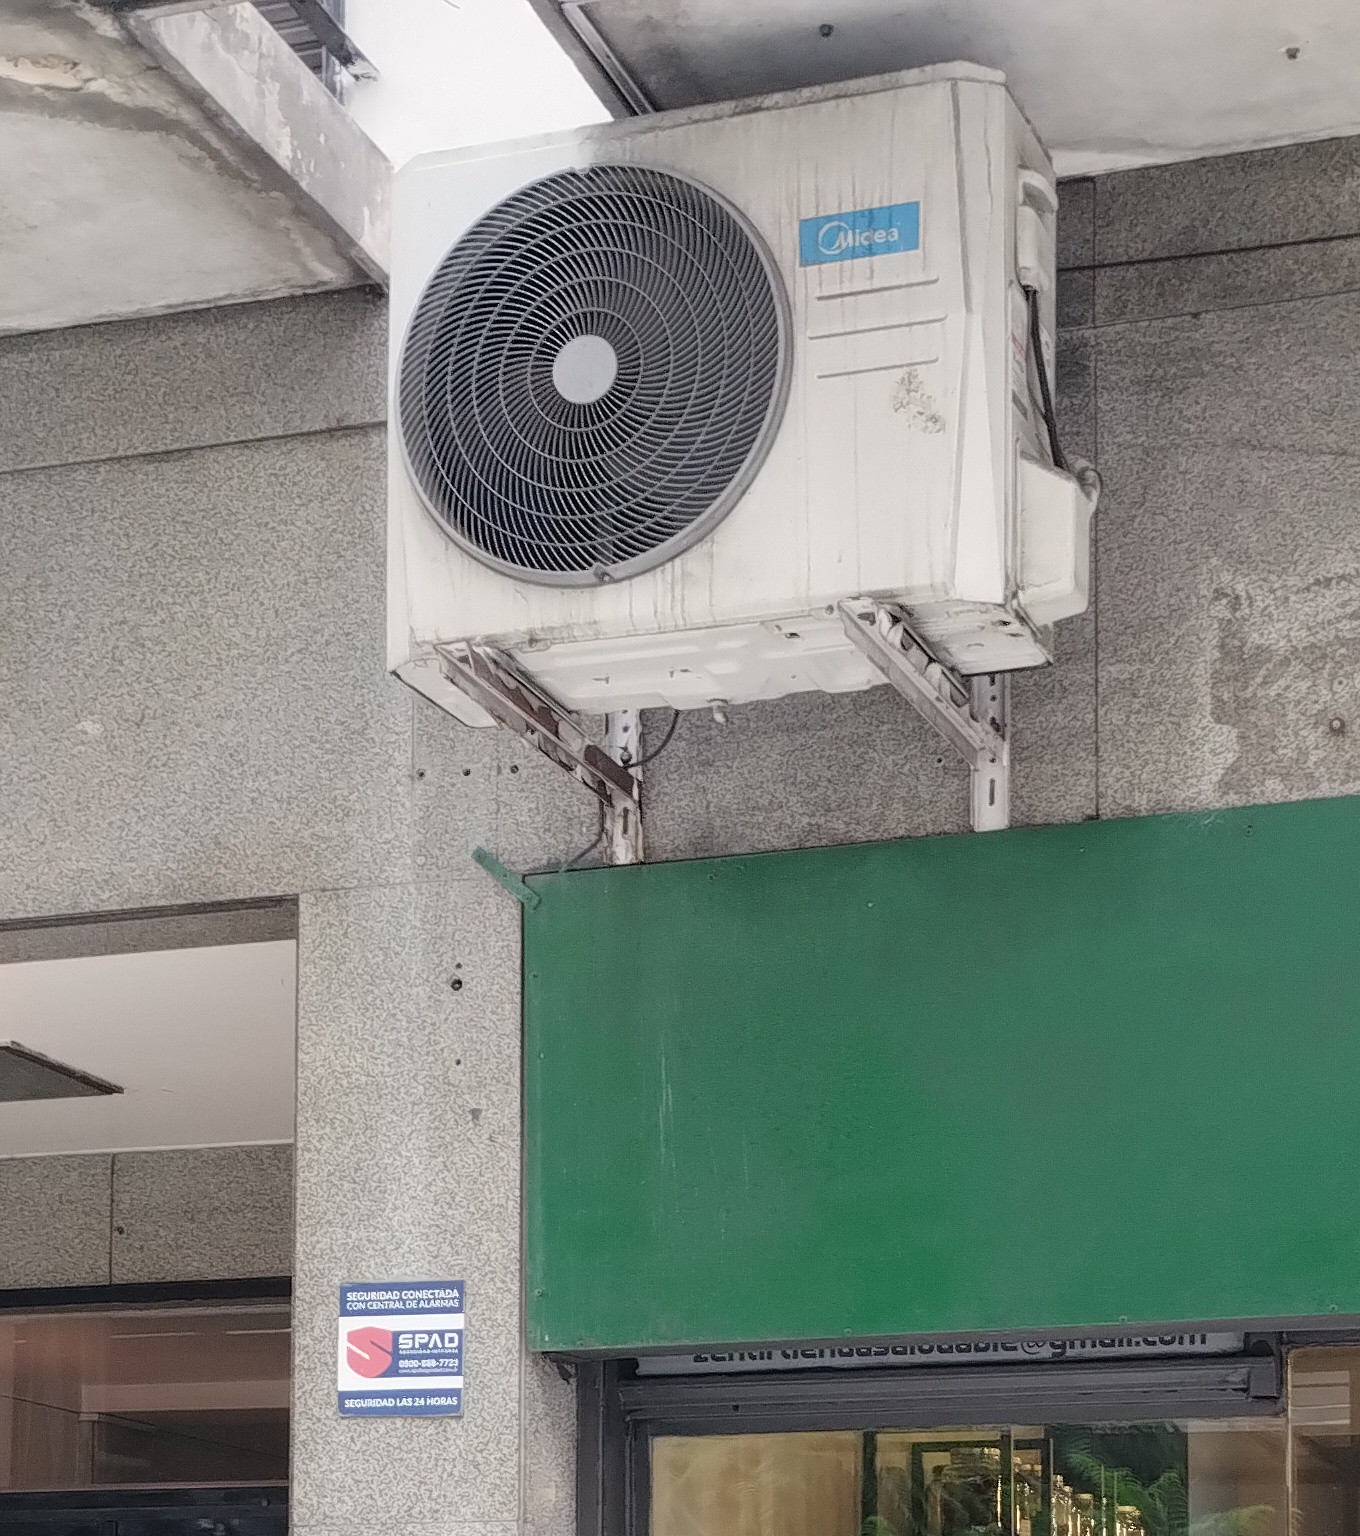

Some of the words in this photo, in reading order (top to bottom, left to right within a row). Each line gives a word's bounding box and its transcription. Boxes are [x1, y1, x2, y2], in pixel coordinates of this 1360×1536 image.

[828, 223, 899, 252] Midea
[346, 1290, 400, 1301] SEGURIDAD
[402, 1288, 459, 1300] CONECTADA
[346, 1301, 365, 1310] CON
[367, 1300, 404, 1310] CENTRAL
[406, 1300, 417, 1309] DE
[419, 1299, 459, 1309] ALARMAS
[398, 1332, 459, 1349] SPAD
[344, 1399, 395, 1408] SEGURIDAD
[396, 1398, 413, 1407] LAS
[426, 1396, 458, 1406] HORAS
